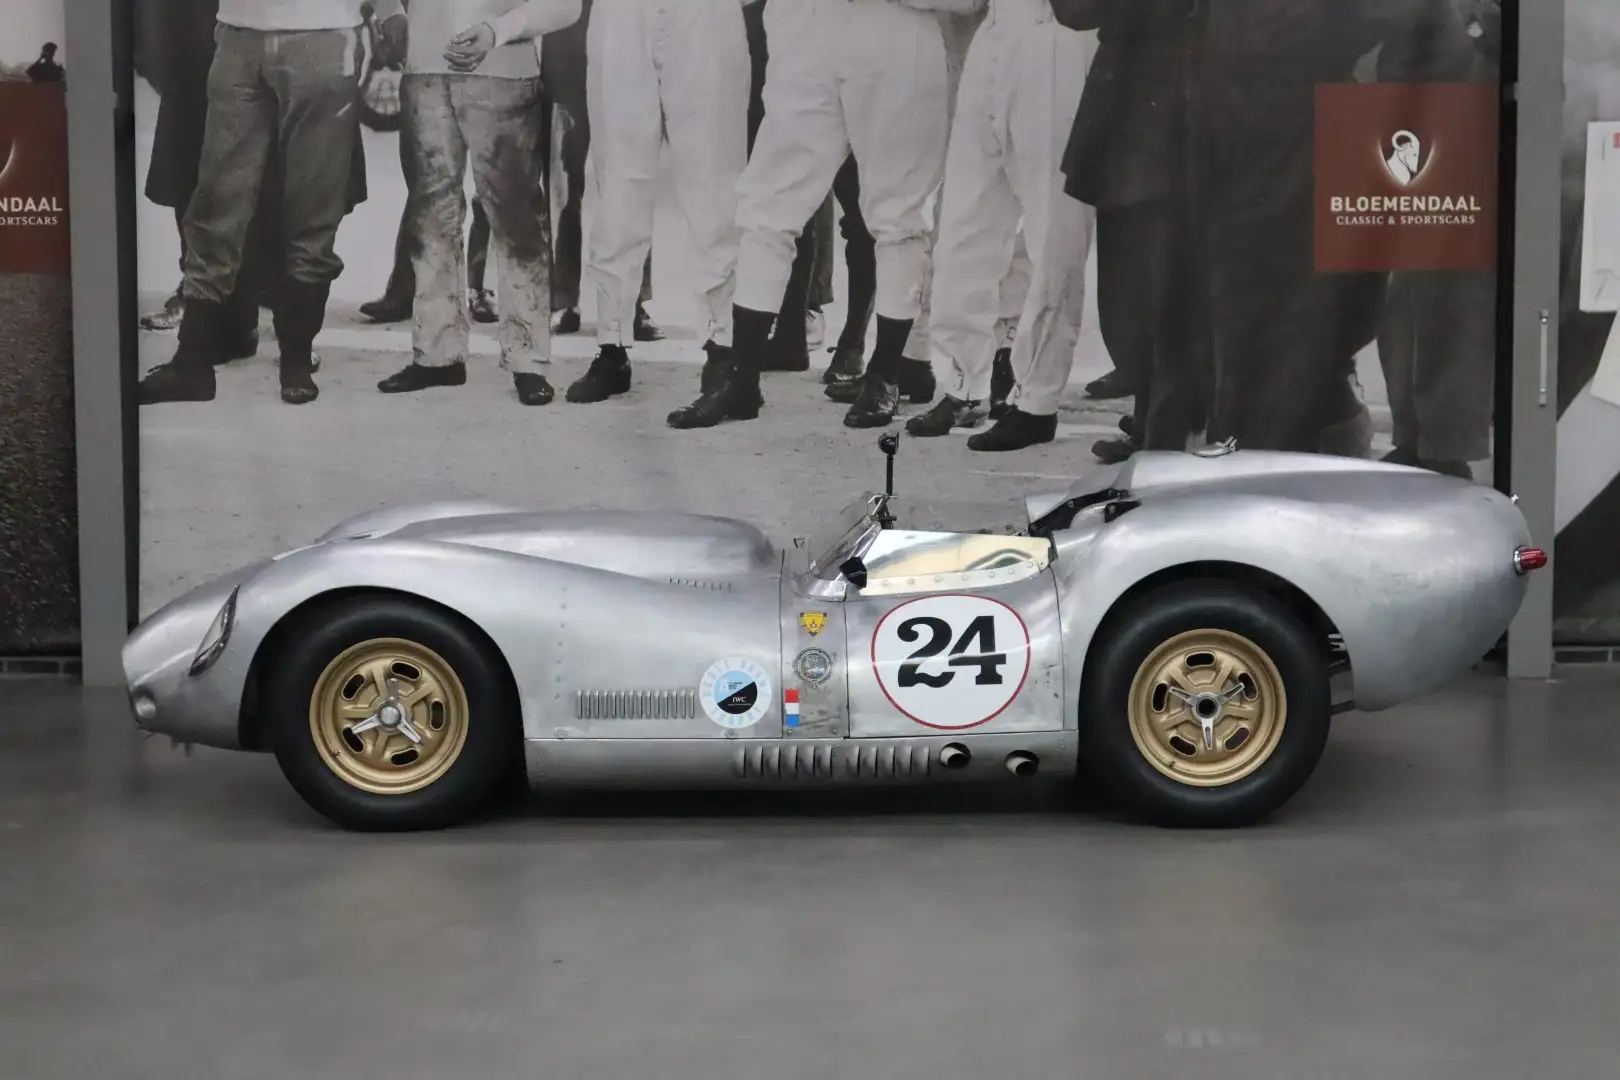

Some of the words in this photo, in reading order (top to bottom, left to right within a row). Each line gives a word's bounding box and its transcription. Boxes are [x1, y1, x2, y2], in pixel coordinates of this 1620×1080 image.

[1330, 196, 1482, 212] BLOEMENDAAL
[1336, 215, 1385, 225] CLASSIC
[1387, 215, 1397, 225] &
[1400, 214, 1476, 225] SPORTSCARS
[897, 615, 1007, 689] 24
